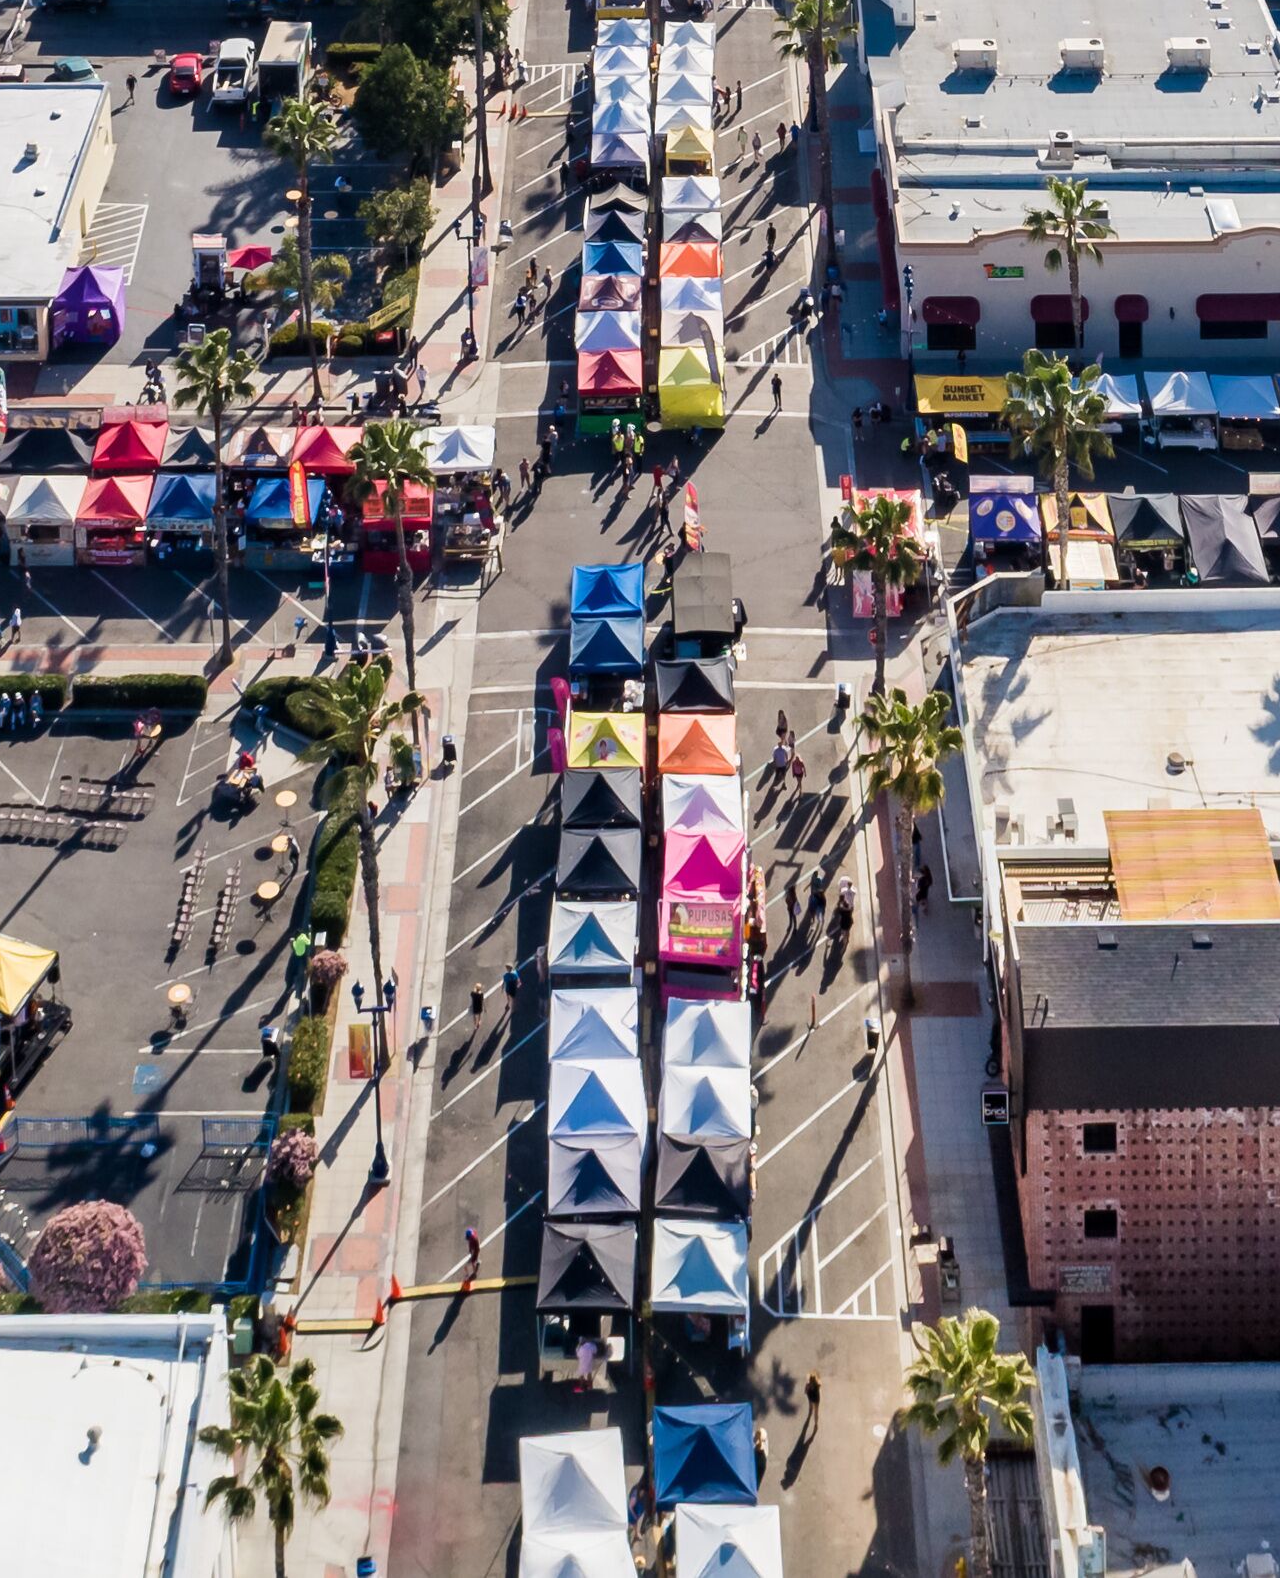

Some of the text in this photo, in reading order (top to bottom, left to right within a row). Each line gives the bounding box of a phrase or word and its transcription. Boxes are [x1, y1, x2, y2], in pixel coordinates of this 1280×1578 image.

[944, 385, 983, 394] SUNSET
[943, 393, 985, 402] MARKET
[688, 909, 733, 922] PUPUSAS
